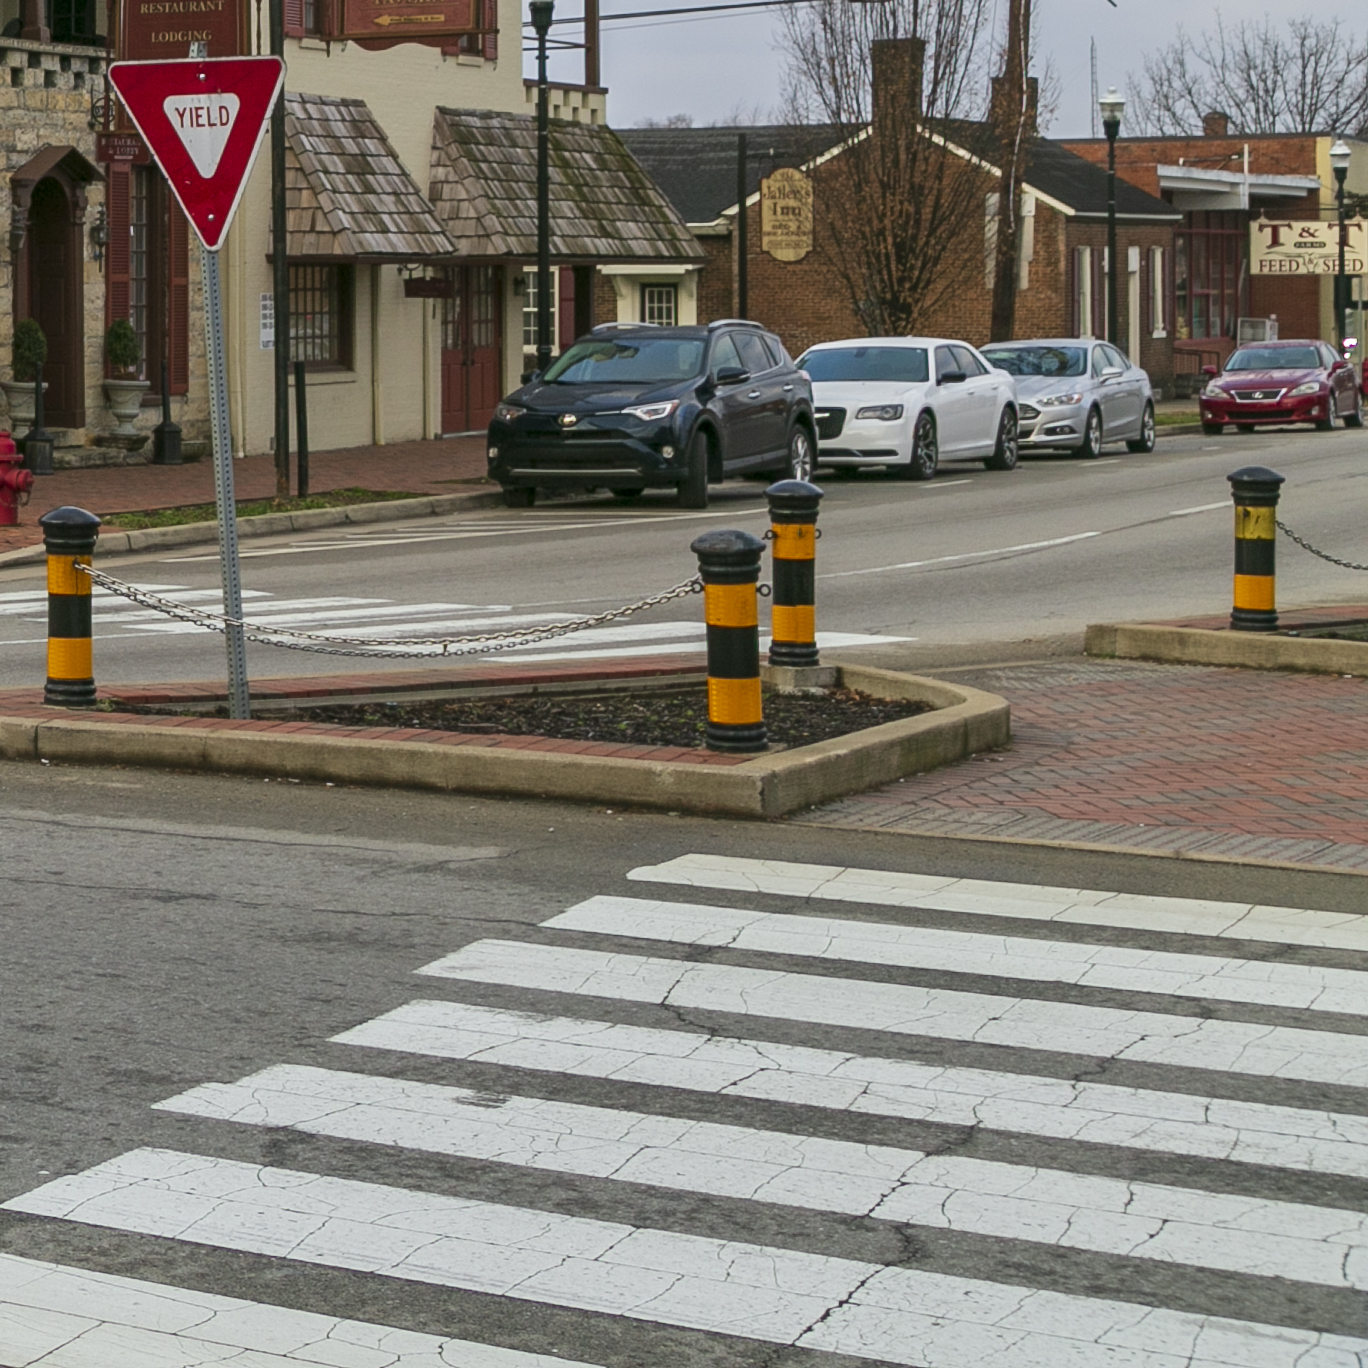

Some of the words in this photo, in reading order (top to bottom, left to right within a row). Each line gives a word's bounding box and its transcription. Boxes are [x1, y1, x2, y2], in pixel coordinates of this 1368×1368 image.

[140, 0, 225, 15] RESTAURANT
[151, 29, 212, 43] LODGING
[174, 105, 230, 128] YIELD
[772, 202, 802, 217] Inn
[1258, 222, 1293, 249] T
[1298, 226, 1319, 238] &
[1327, 222, 1363, 249] T
[1259, 259, 1300, 272] FEED
[1323, 259, 1364, 272] SEED
